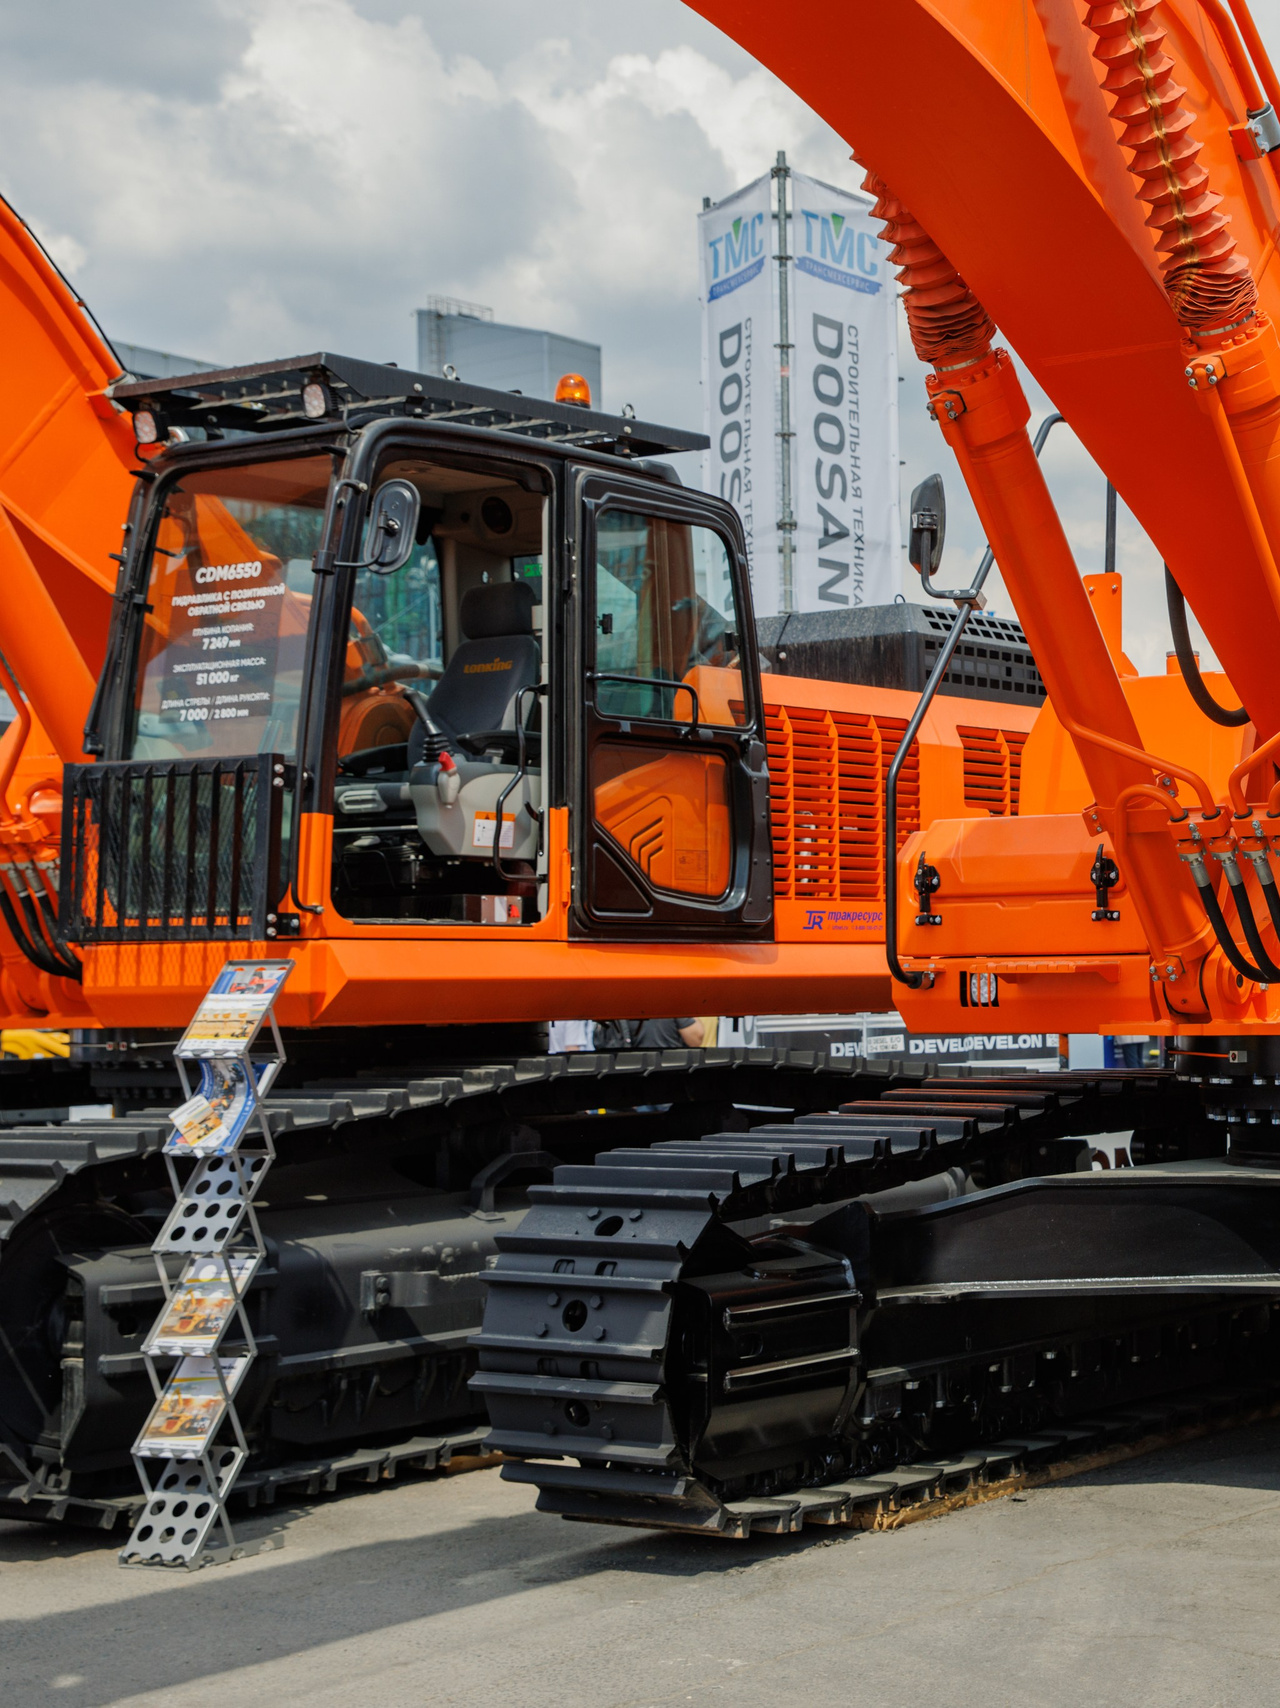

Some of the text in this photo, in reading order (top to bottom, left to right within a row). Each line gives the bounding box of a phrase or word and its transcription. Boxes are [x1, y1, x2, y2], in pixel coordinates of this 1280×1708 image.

[719, 322, 743, 503] DOOS
[743, 317, 754, 586] СТРОИТЕЛЬНАЯ ТЕХН
[812, 312, 850, 606] DOOSAN
[847, 324, 865, 607] СТРОИТЕЛЬНАЯ ТЕХНИКА
[195, 561, 262, 584] CDM6550
[171, 592, 223, 606] ГИДРАВЛИКА
[231, 583, 285, 600] ПОЗИТИВНОЙ
[187, 599, 266, 617] ОБРАТНОЙ СВЯЗЬЮ
[209, 636, 229, 650] 249
[196, 672, 207, 685] 51
[210, 671, 230, 684] 000
[187, 708, 208, 721] 000
[221, 708, 237, 719] 800
[827, 911, 883, 923] тракресурс
[909, 1037, 967, 1054] DEVEL
